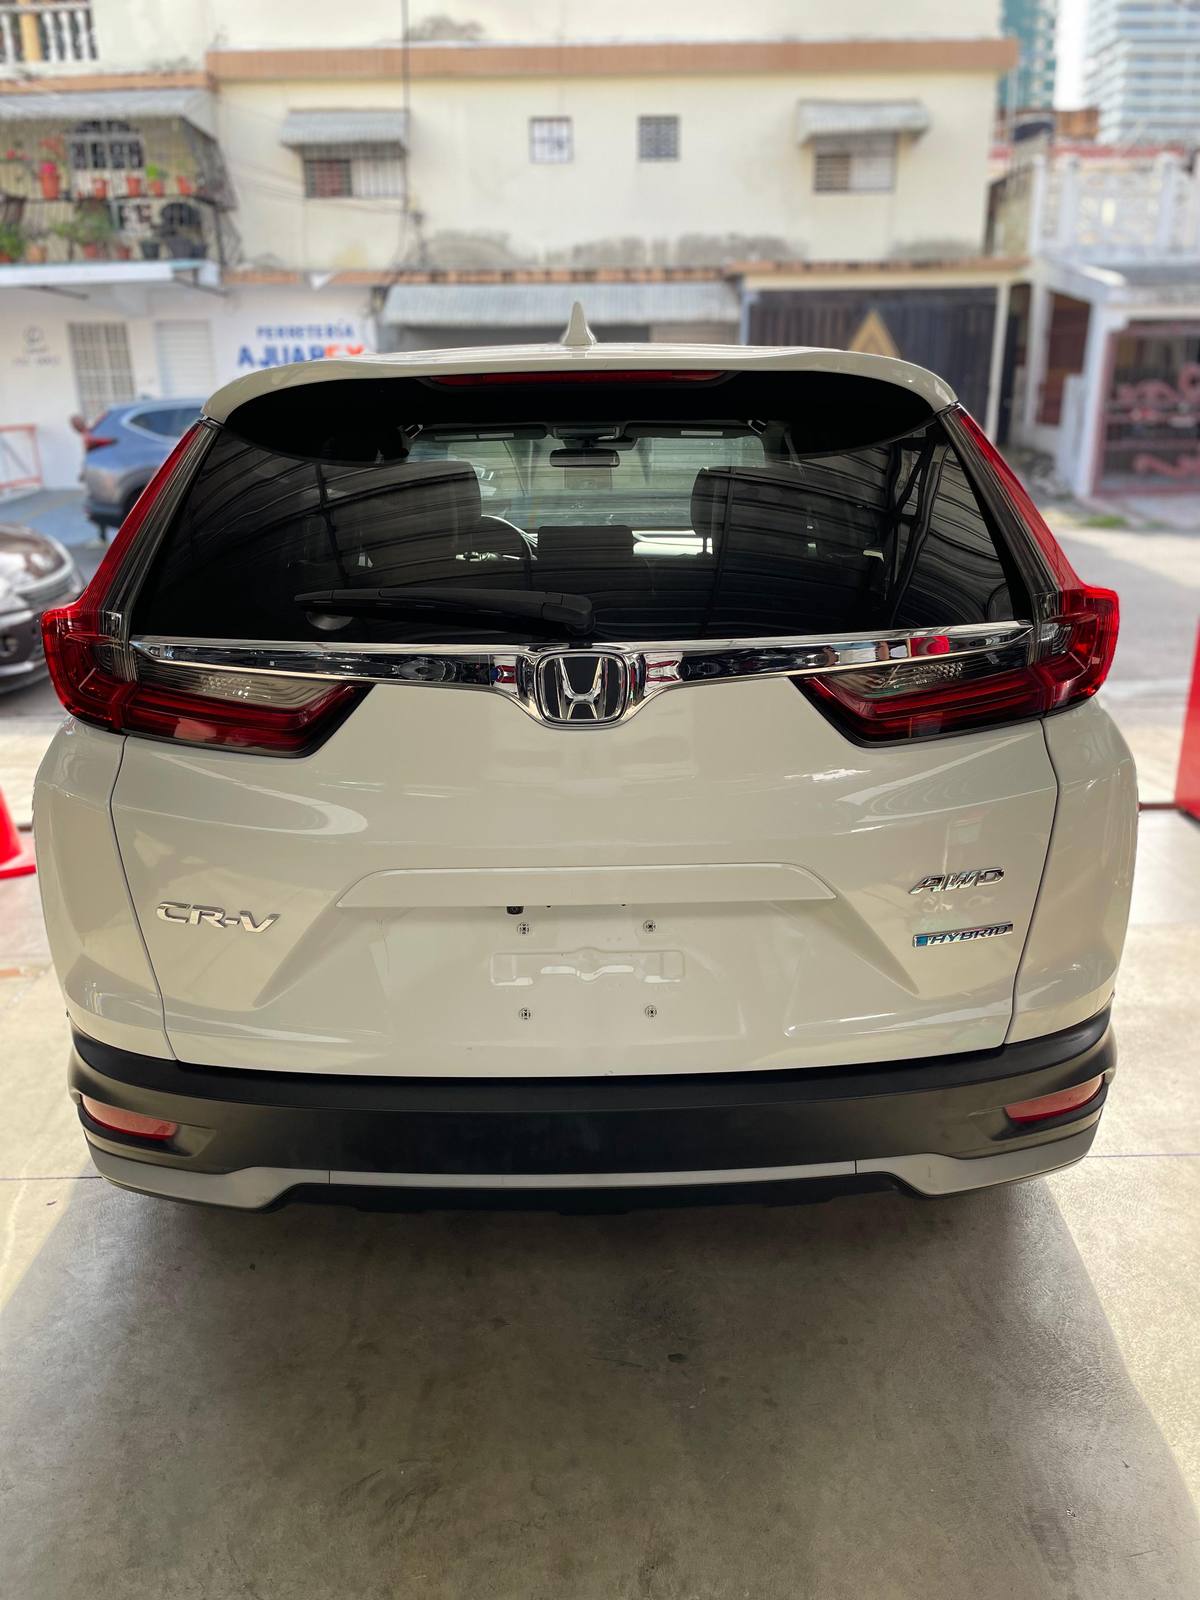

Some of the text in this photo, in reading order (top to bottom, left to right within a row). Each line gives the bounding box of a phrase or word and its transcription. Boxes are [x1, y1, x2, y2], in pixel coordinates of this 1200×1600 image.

[908, 867, 1005, 895] AWD
[156, 901, 280, 933] CR-V
[929, 925, 1009, 945] HYBRID
